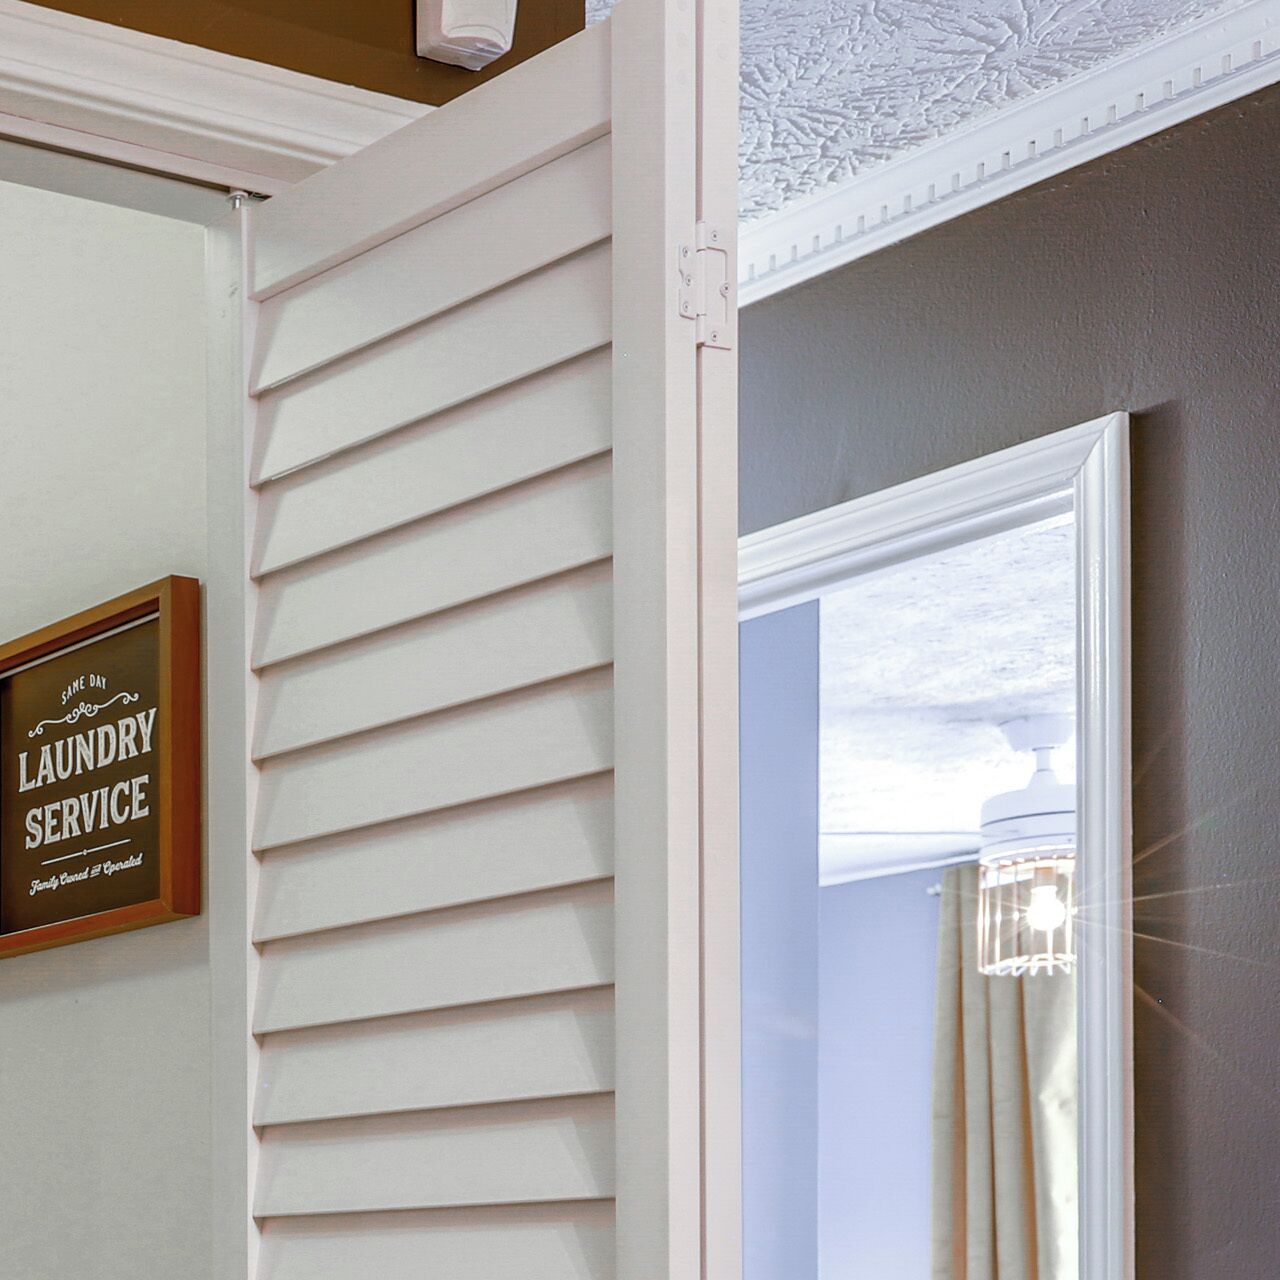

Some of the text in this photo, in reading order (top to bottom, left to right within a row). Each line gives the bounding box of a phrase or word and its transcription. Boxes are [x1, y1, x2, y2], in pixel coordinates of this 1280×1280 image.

[61, 673, 107, 705] SAME DAY
[18, 707, 158, 793] LAUNDRY
[25, 774, 150, 850] SERVICE
[29, 875, 60, 896] Family
[59, 867, 90, 886] Owned
[103, 852, 144, 876] Operated
